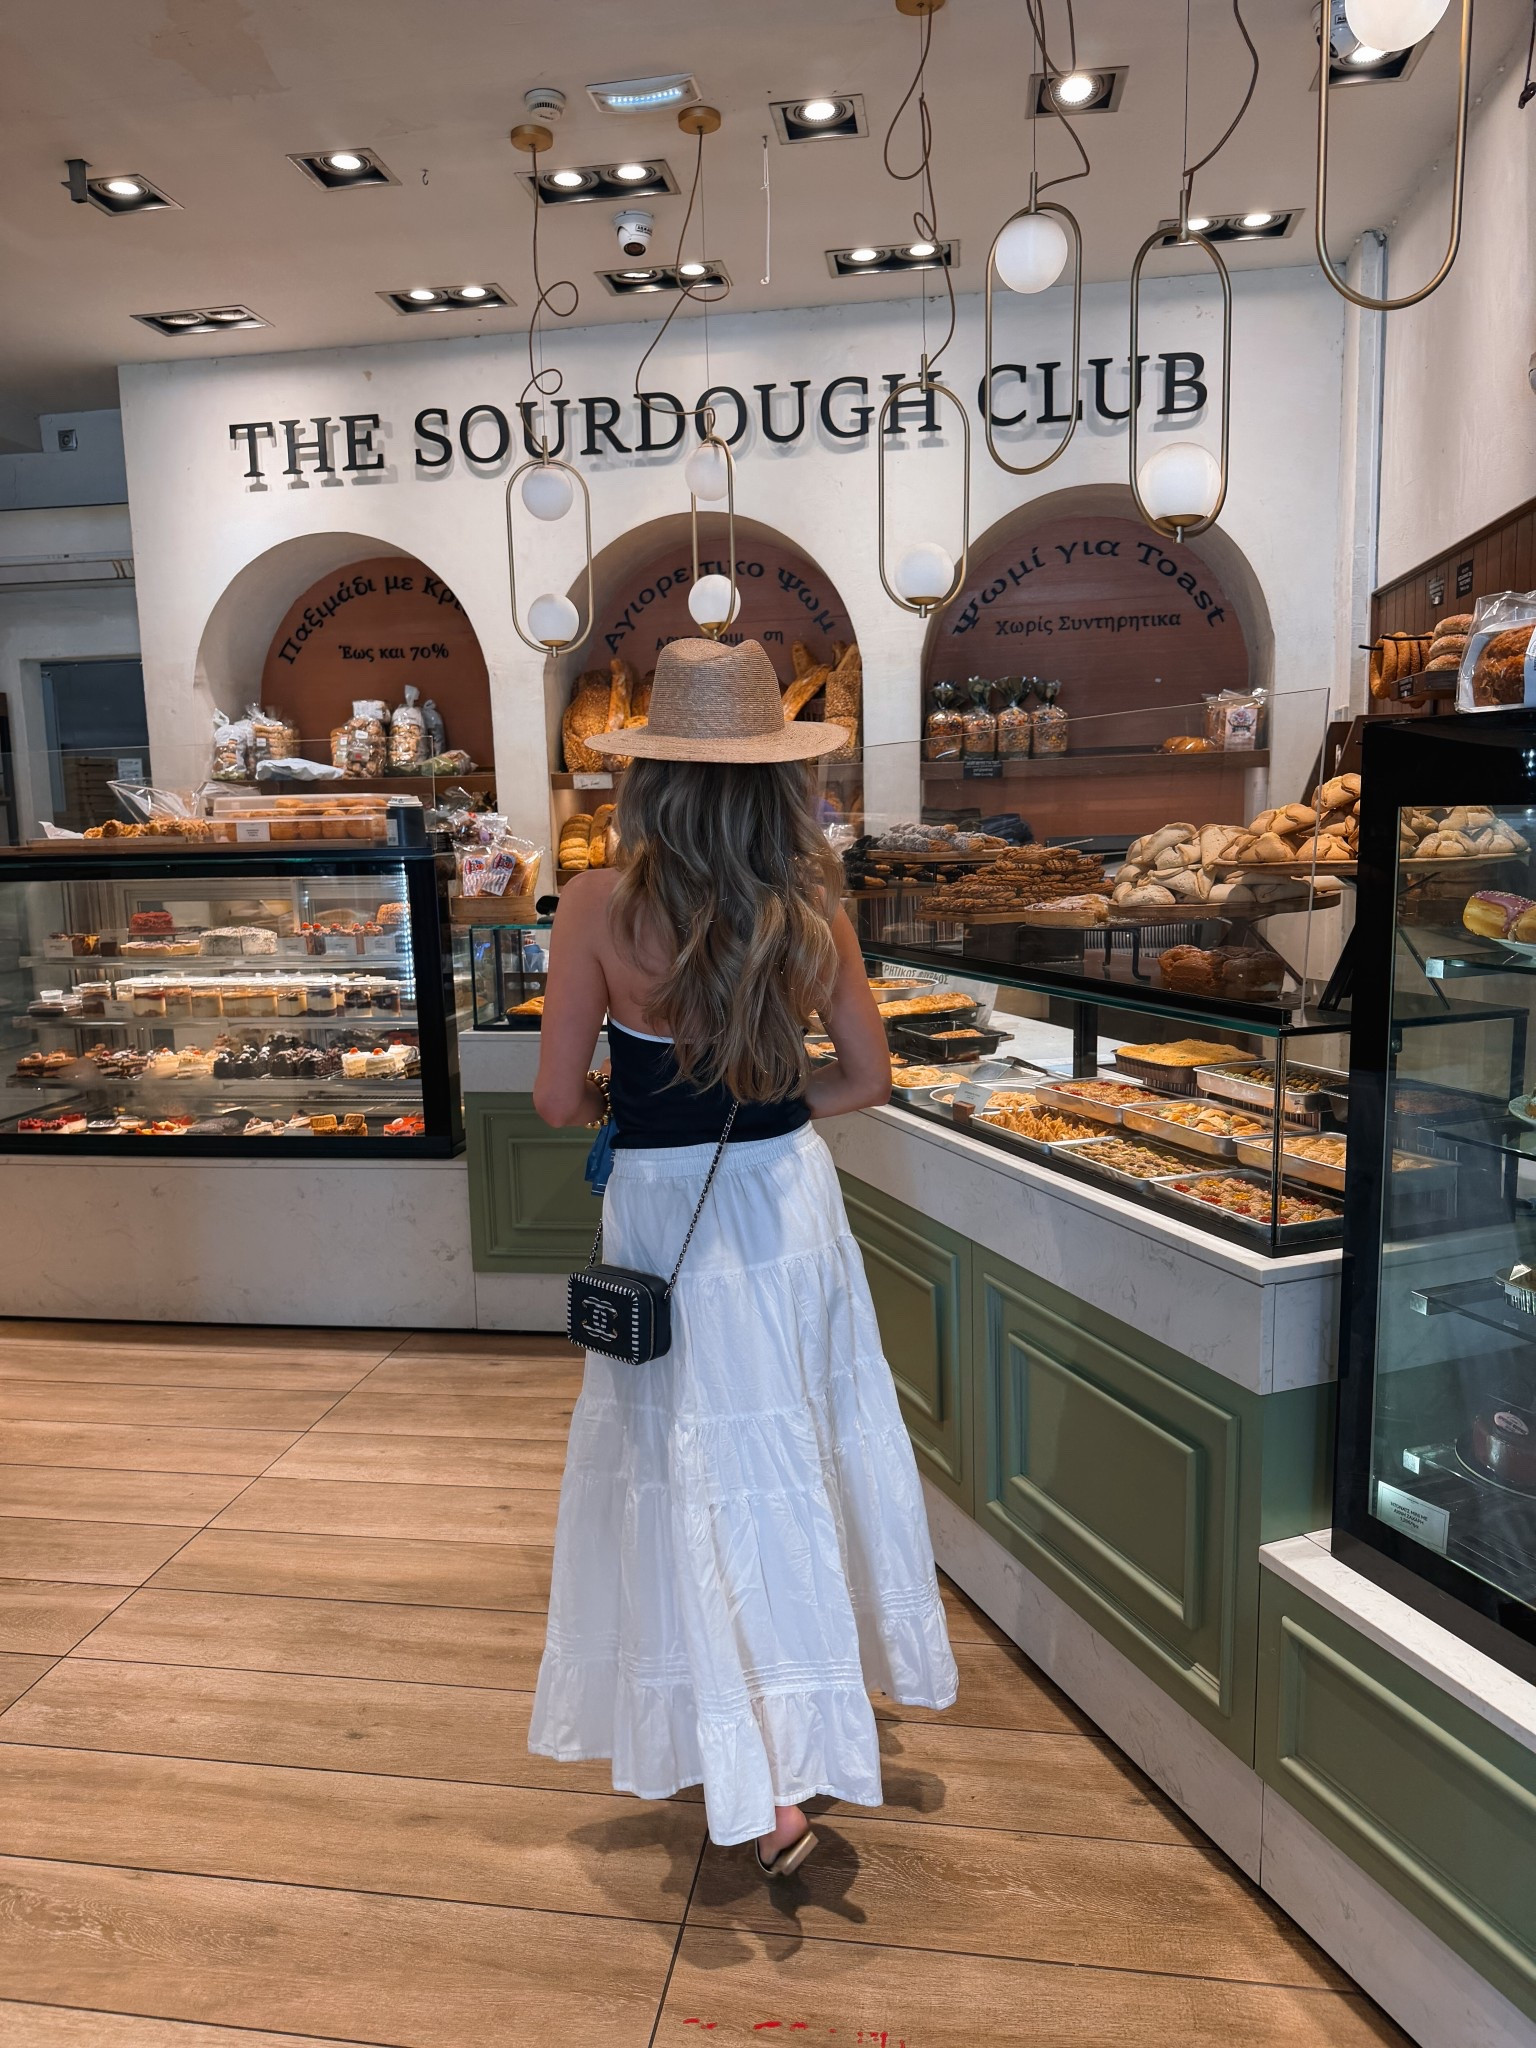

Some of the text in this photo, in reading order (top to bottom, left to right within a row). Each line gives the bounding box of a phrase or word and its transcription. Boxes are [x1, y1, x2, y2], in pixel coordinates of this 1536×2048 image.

[229, 351, 1209, 478] THE SOURDOUGH CLUB
[278, 575, 376, 665] Παξιμάδι
[384, 575, 414, 595] με
[952, 539, 1225, 636] Ψωμί για Toast
[995, 613, 1181, 637] Χωρίς Συντηρητικα
[379, 646, 406, 659] και
[410, 643, 449, 661] 70%
